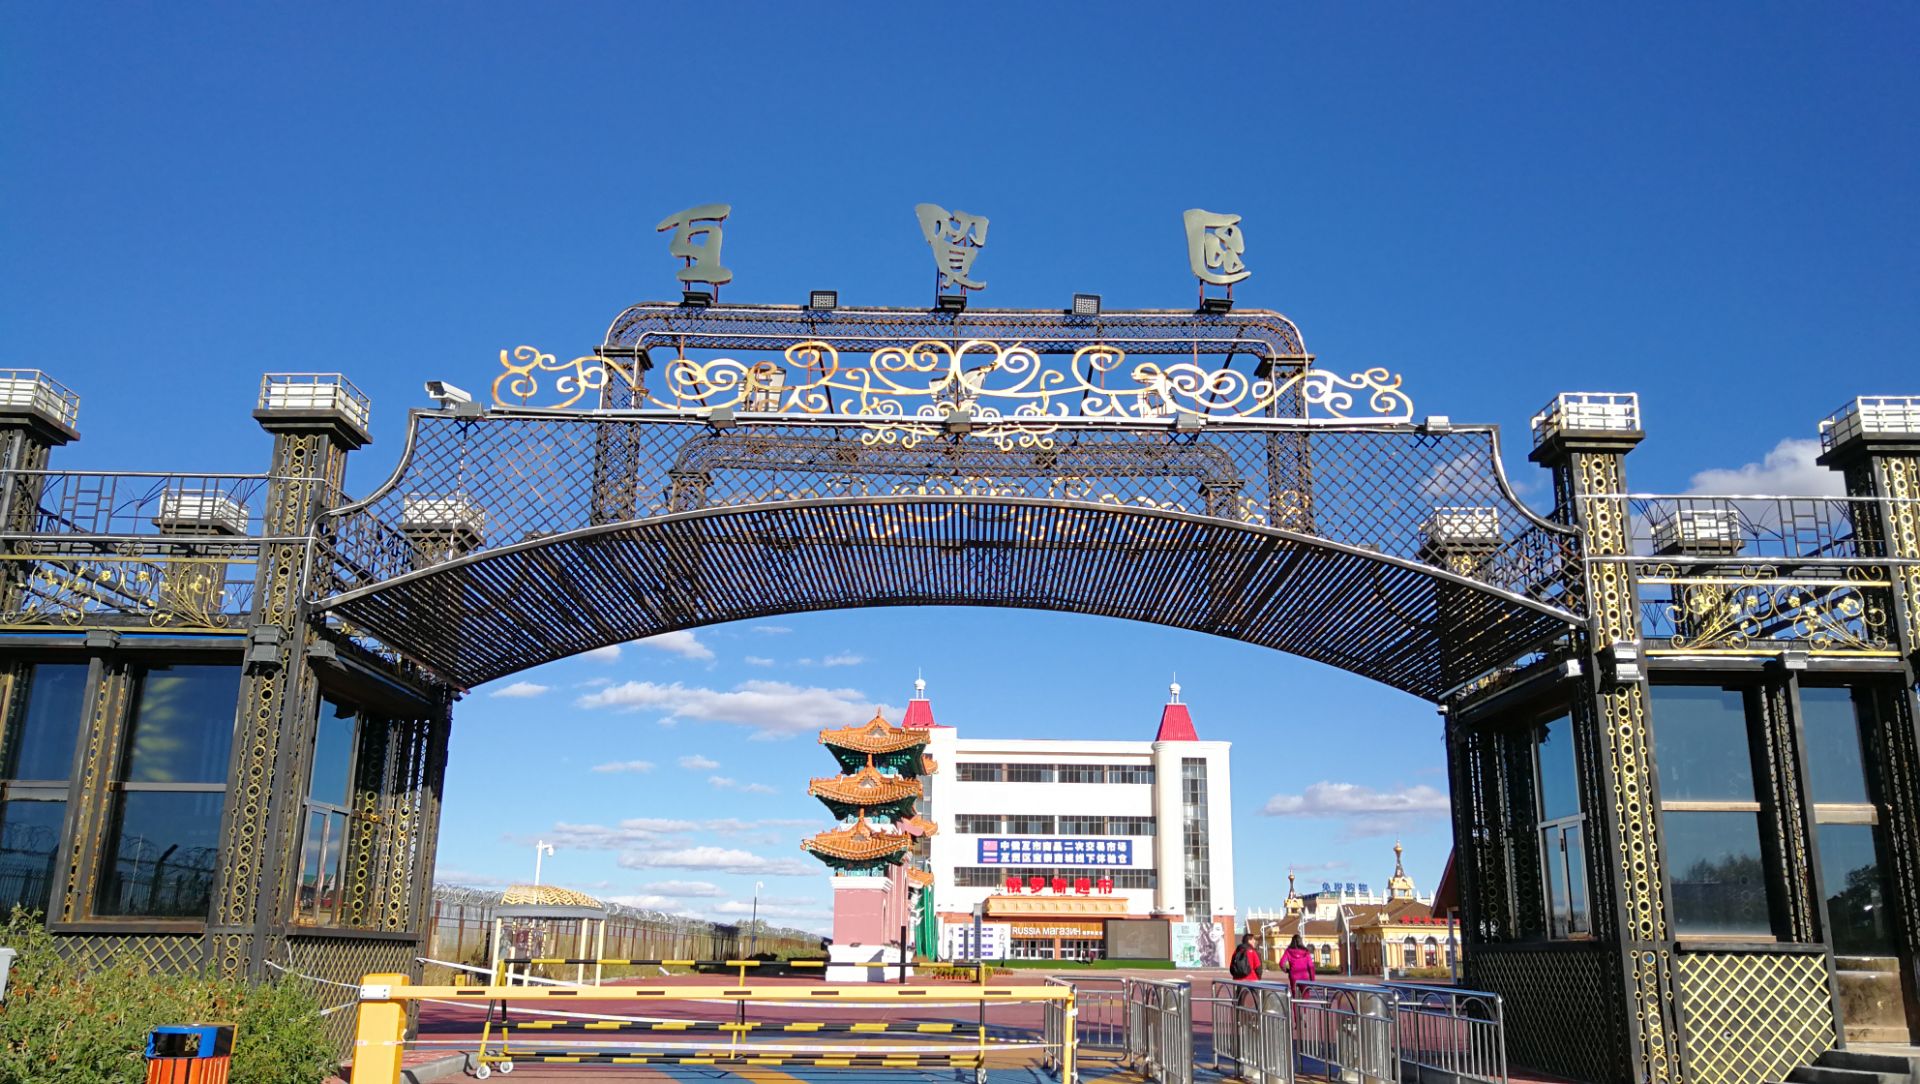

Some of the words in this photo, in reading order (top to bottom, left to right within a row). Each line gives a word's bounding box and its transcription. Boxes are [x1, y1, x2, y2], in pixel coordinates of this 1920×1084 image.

[1006, 876, 1113, 894] 俄罗斯超市
[1012, 926, 1041, 935] RUSSIA
